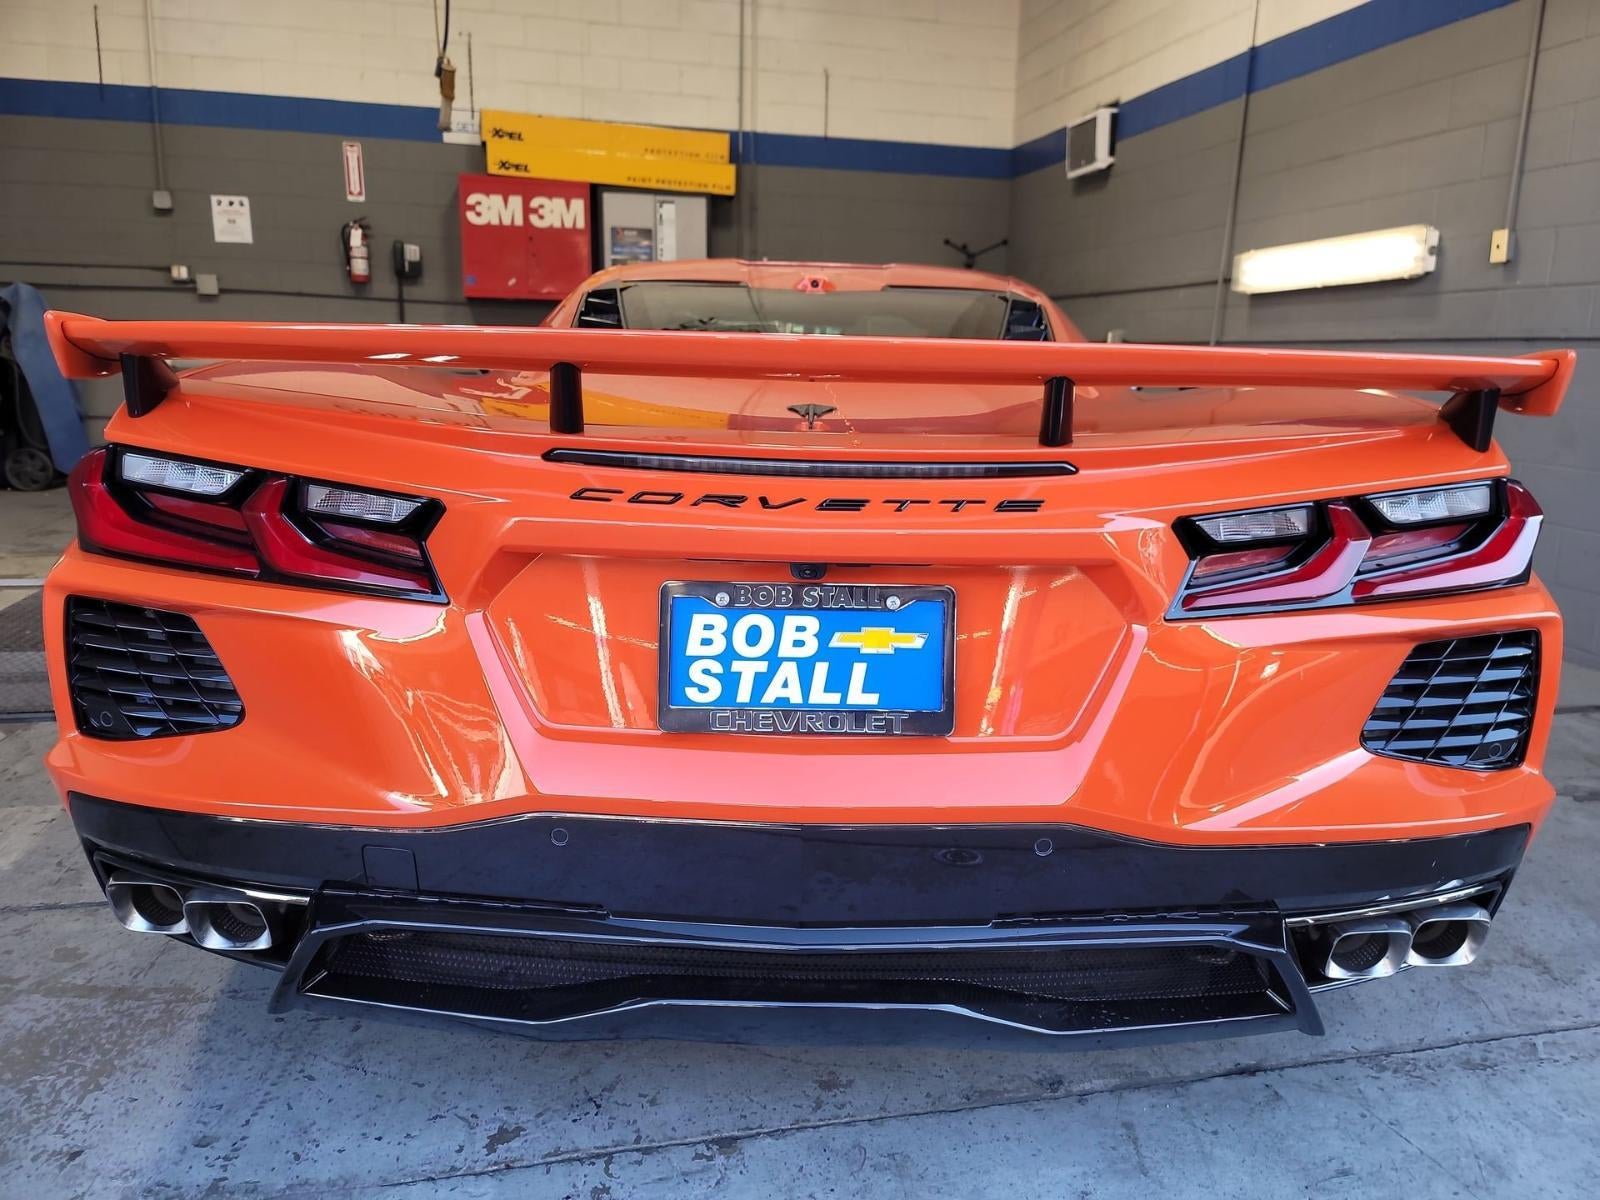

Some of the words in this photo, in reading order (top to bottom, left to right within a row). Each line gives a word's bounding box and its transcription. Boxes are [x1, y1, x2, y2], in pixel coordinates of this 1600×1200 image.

[465, 193, 524, 226] 3M
[528, 195, 586, 229] 3M
[569, 486, 1046, 513] CORVETTE
[734, 585, 793, 608] BOB
[802, 586, 883, 609] STALL
[685, 613, 821, 659] BOB
[684, 658, 881, 706] STALL
[709, 709, 910, 734] CHEVROLET
